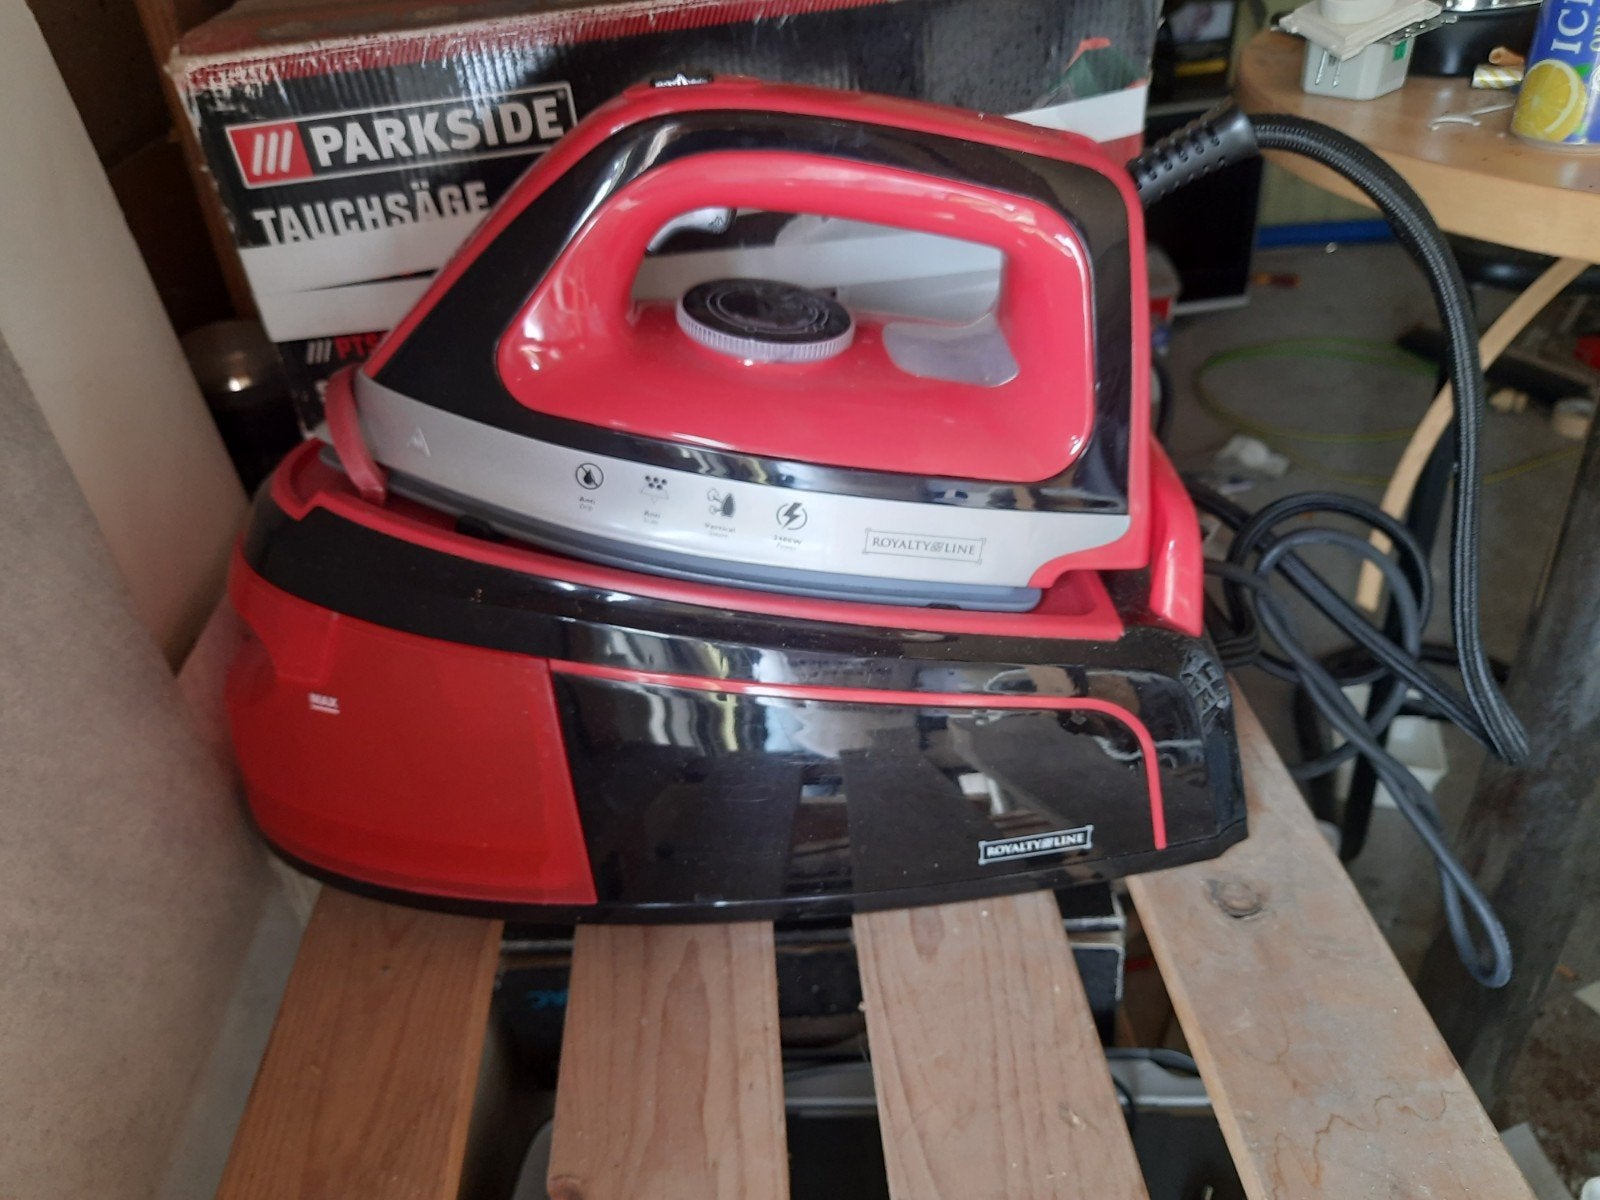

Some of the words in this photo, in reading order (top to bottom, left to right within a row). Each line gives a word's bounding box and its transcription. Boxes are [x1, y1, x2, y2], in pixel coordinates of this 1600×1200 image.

[1550, 0, 1594, 55] IC
[309, 97, 565, 168] PARKSIDE
[252, 180, 490, 245] TAUCHSÄGE
[872, 536, 932, 551] ROYALTY
[944, 542, 976, 555] LINE
[308, 692, 339, 708] MAX
[986, 837, 1042, 857] ROYALTY
[1052, 832, 1085, 847] LINE
